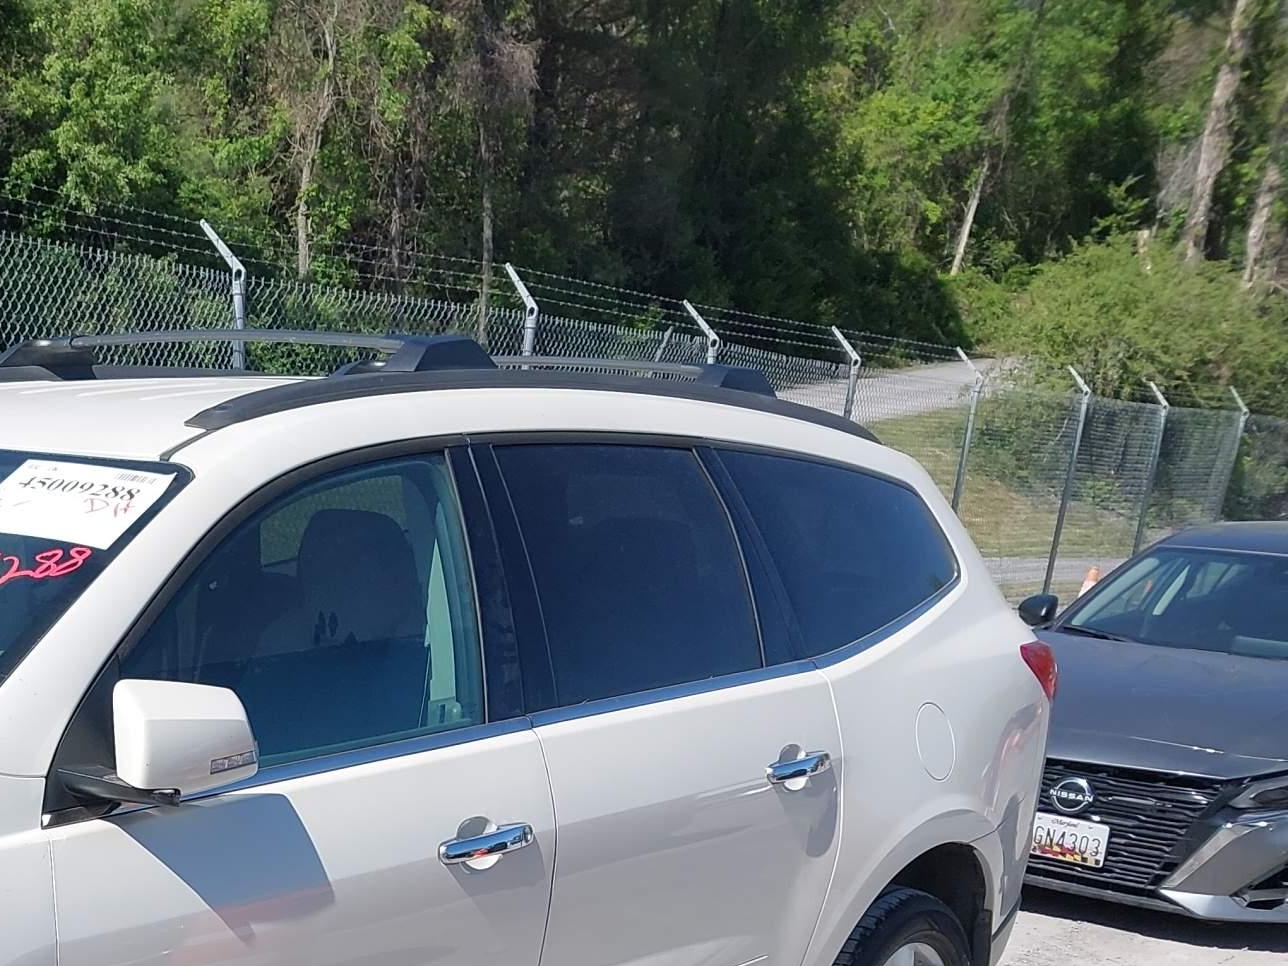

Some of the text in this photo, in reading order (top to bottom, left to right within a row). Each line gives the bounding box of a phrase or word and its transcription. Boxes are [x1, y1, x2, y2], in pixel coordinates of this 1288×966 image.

[18, 476, 141, 501] 45009288
[1049, 789, 1094, 802] NISSAN
[1033, 825, 1101, 857] GN4303
